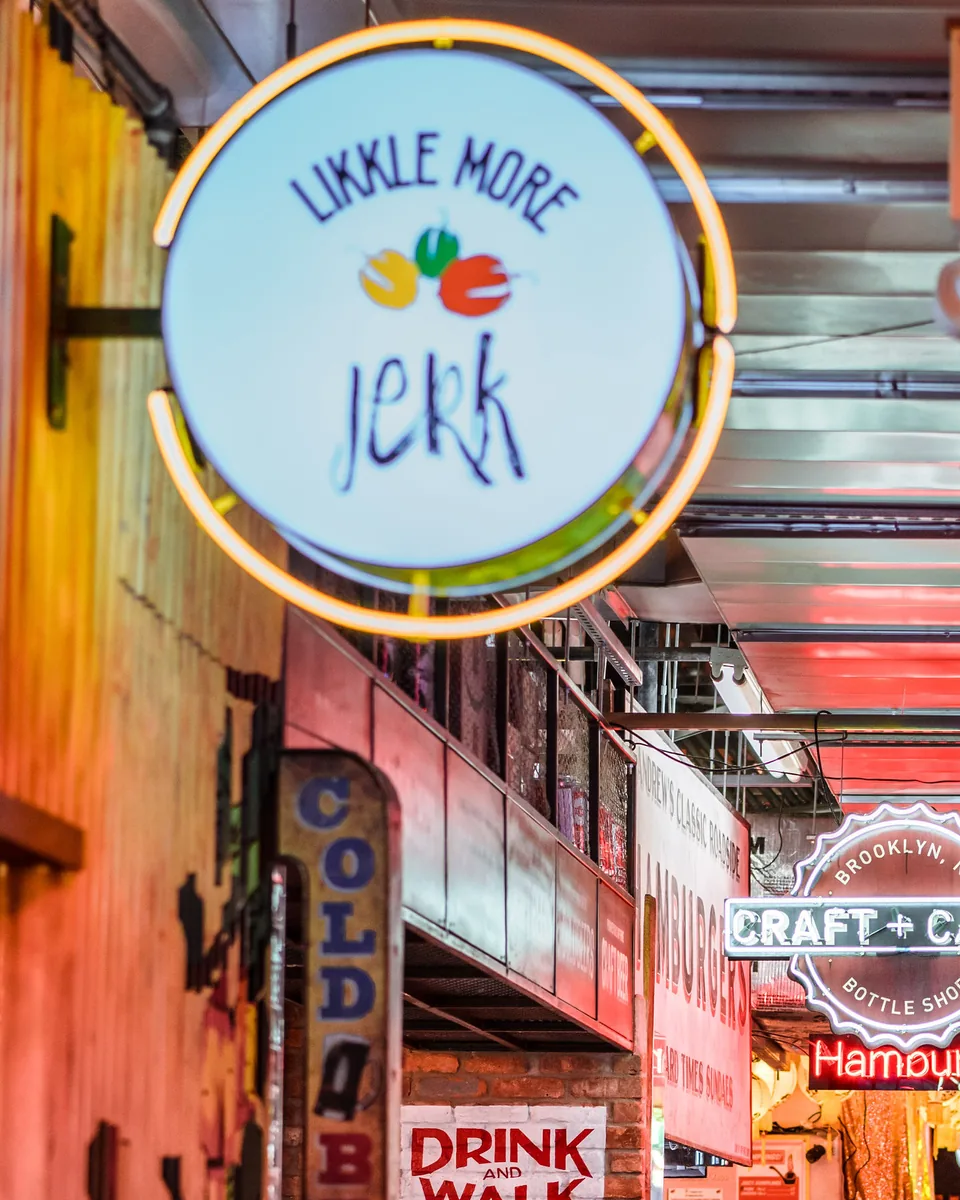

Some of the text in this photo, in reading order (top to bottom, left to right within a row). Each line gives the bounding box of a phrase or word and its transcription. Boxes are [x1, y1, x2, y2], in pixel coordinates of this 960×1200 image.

[290, 133, 581, 234] LIKKLE MORE
[677, 788, 707, 849] CLASSIC
[710, 820, 741, 880] ROADSIDE
[835, 839, 945, 886] BROOKLYN,
[299, 775, 376, 1022] COLD
[733, 908, 877, 946] CRAFT
[842, 976, 915, 1016] BOTTLE
[681, 1053, 703, 1096] TIMES
[706, 1065, 733, 1109] SUNDAES
[411, 1127, 595, 1178] DRINK
[483, 1167, 521, 1180] AND
